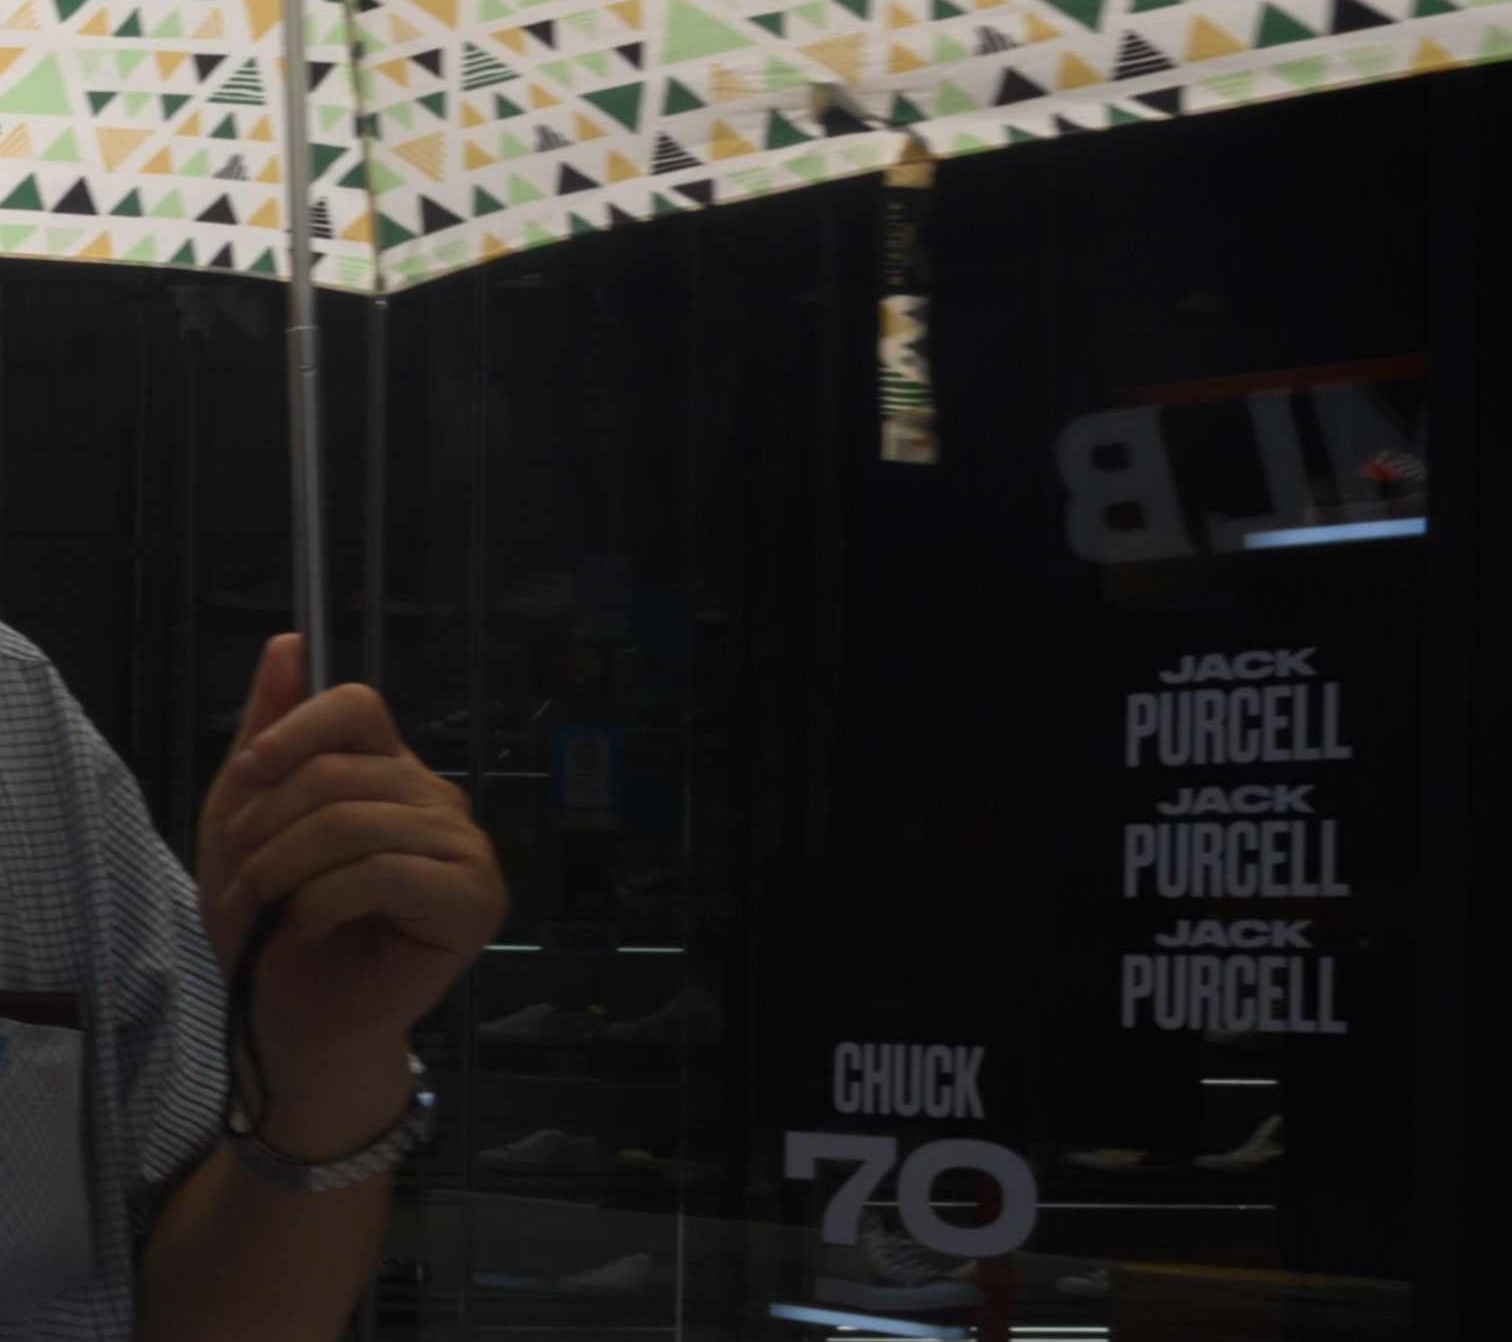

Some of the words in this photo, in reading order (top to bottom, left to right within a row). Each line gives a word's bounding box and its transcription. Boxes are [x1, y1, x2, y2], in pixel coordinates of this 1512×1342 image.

[1159, 647, 1319, 685] JACK
[1124, 682, 1354, 769] PURCELL
[1157, 784, 1317, 817] JACK
[1123, 819, 1352, 899] PURCELL
[1154, 918, 1314, 949] JACK
[1120, 954, 1349, 1035] PURCELL
[832, 1041, 986, 1121] CHUCK
[784, 1130, 1040, 1259] 70
